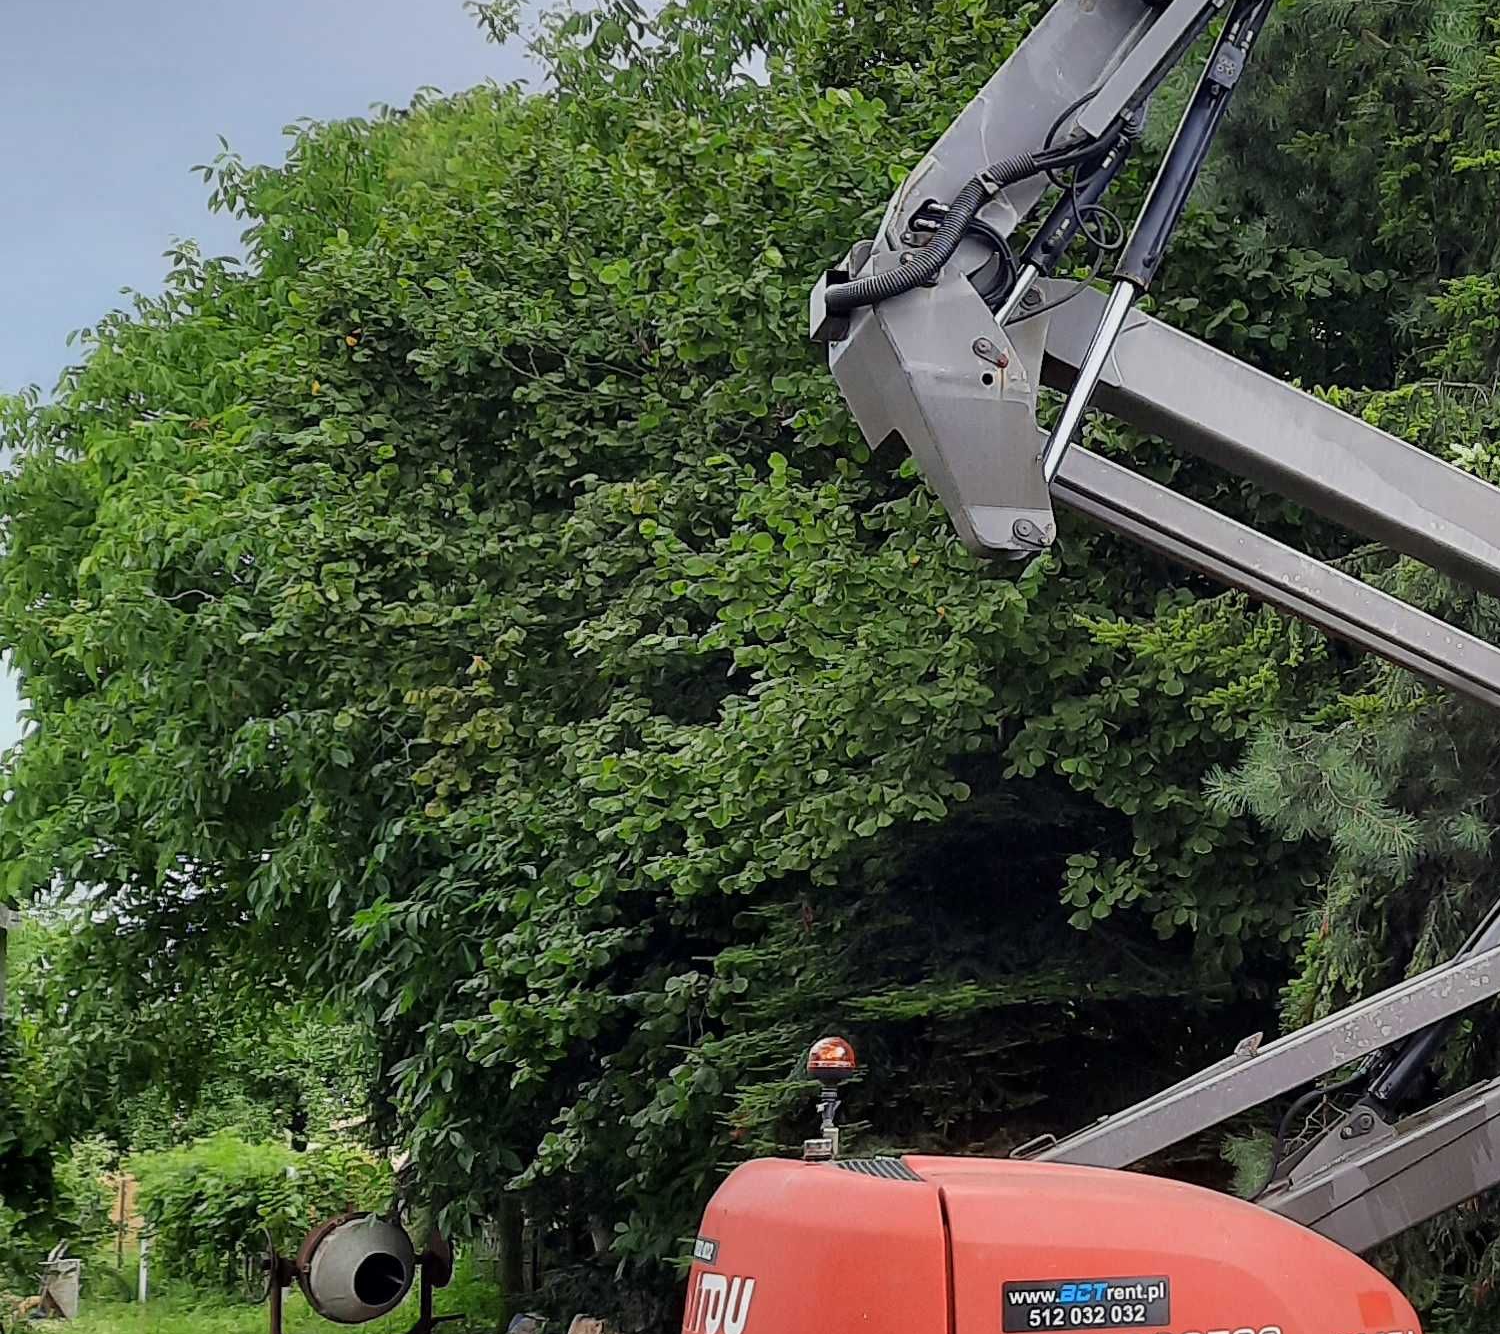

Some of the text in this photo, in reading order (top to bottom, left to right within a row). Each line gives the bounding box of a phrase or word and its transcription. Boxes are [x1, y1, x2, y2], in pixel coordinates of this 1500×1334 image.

[1029, 1304, 1146, 1327] 512 032 032
